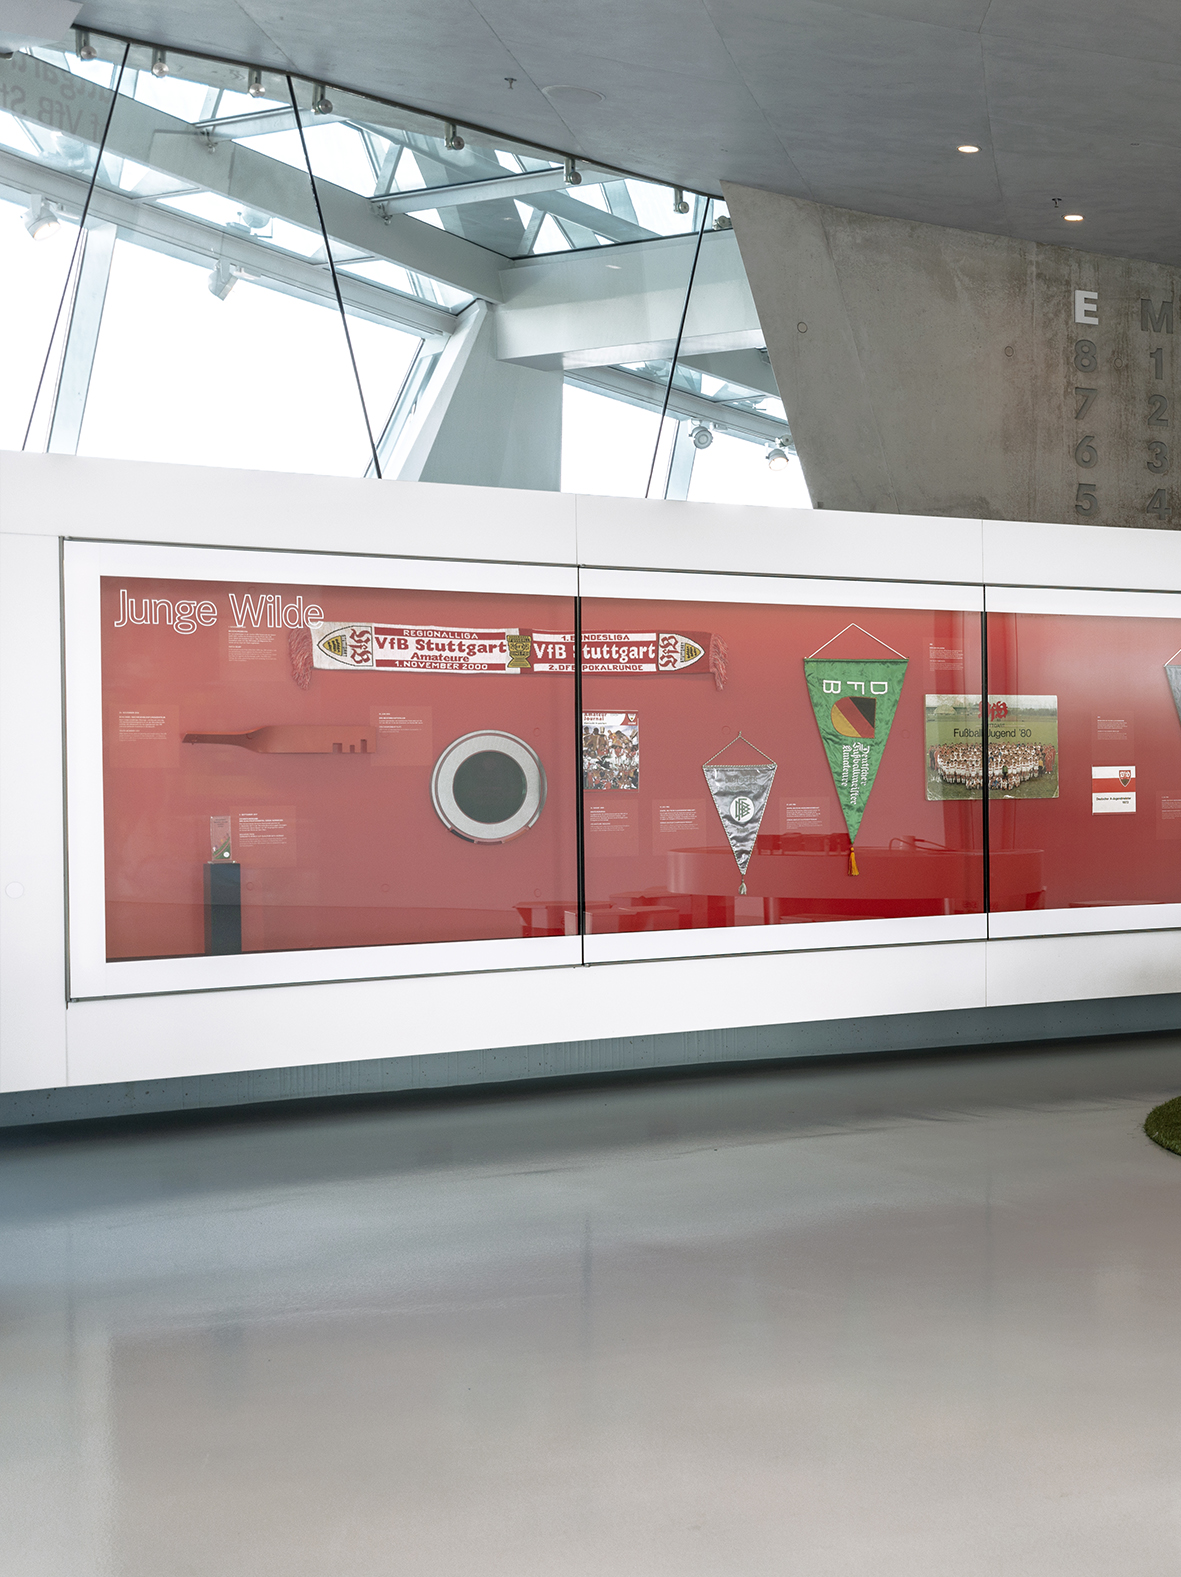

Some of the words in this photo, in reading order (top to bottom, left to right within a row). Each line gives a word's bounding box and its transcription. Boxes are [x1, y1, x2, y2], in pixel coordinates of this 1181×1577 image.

[1074, 289, 1099, 326] E
[1140, 298, 1174, 334] M
[1073, 339, 1098, 373] 8
[1149, 347, 1164, 380] 1
[1074, 386, 1098, 420] 7
[1147, 394, 1169, 427] 2
[1074, 435, 1098, 469] 6
[1146, 440, 1169, 474] 3
[1074, 483, 1098, 517] 5
[1145, 488, 1171, 521] 4
[114, 588, 218, 634] Junge
[227, 592, 325, 630] Wilde
[374, 636, 410, 651] VfB
[415, 638, 507, 657] Stuttgart
[403, 629, 479, 640] REGIONALLIGA
[533, 642, 567, 659] VfB
[572, 642, 656, 663] tuttgart
[410, 651, 470, 663] Amateure
